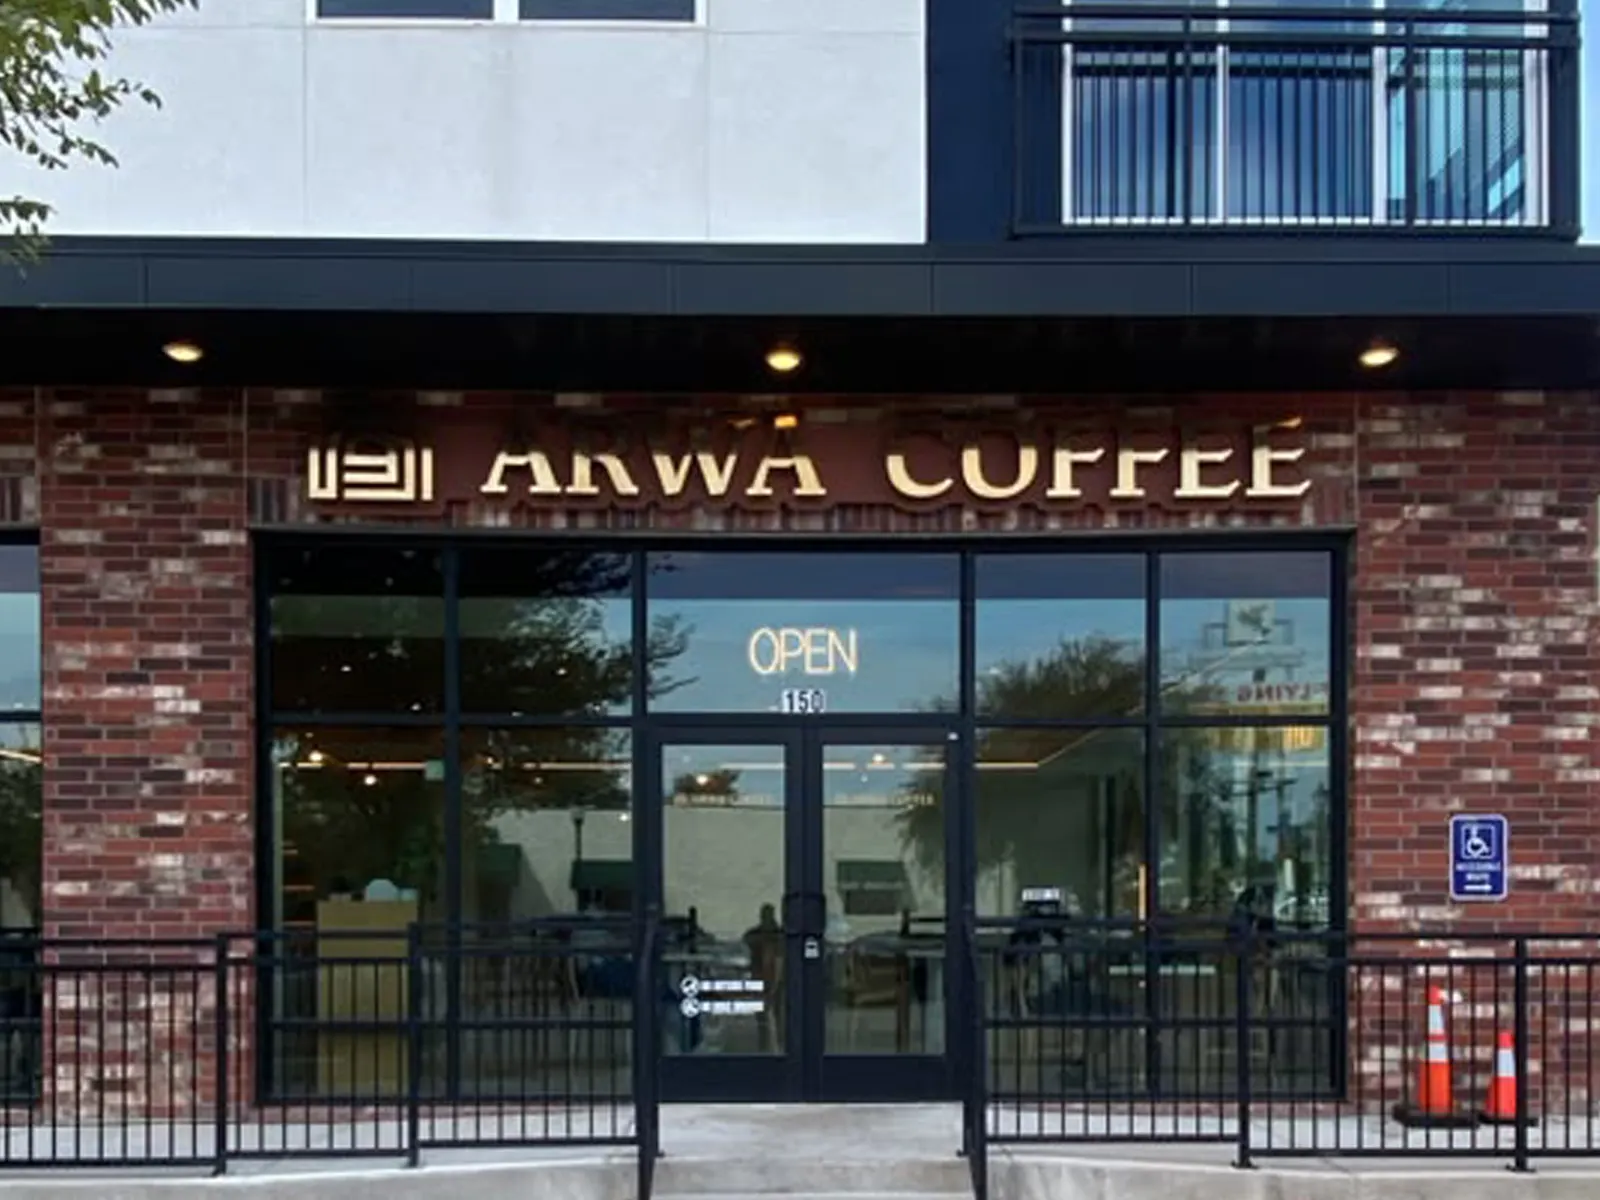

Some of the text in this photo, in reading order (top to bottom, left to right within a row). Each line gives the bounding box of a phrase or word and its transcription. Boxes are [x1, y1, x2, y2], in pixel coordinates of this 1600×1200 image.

[480, 416, 1312, 498] ARWA COFFEE
[749, 627, 857, 675] OPEN
[785, 689, 825, 712] 150
